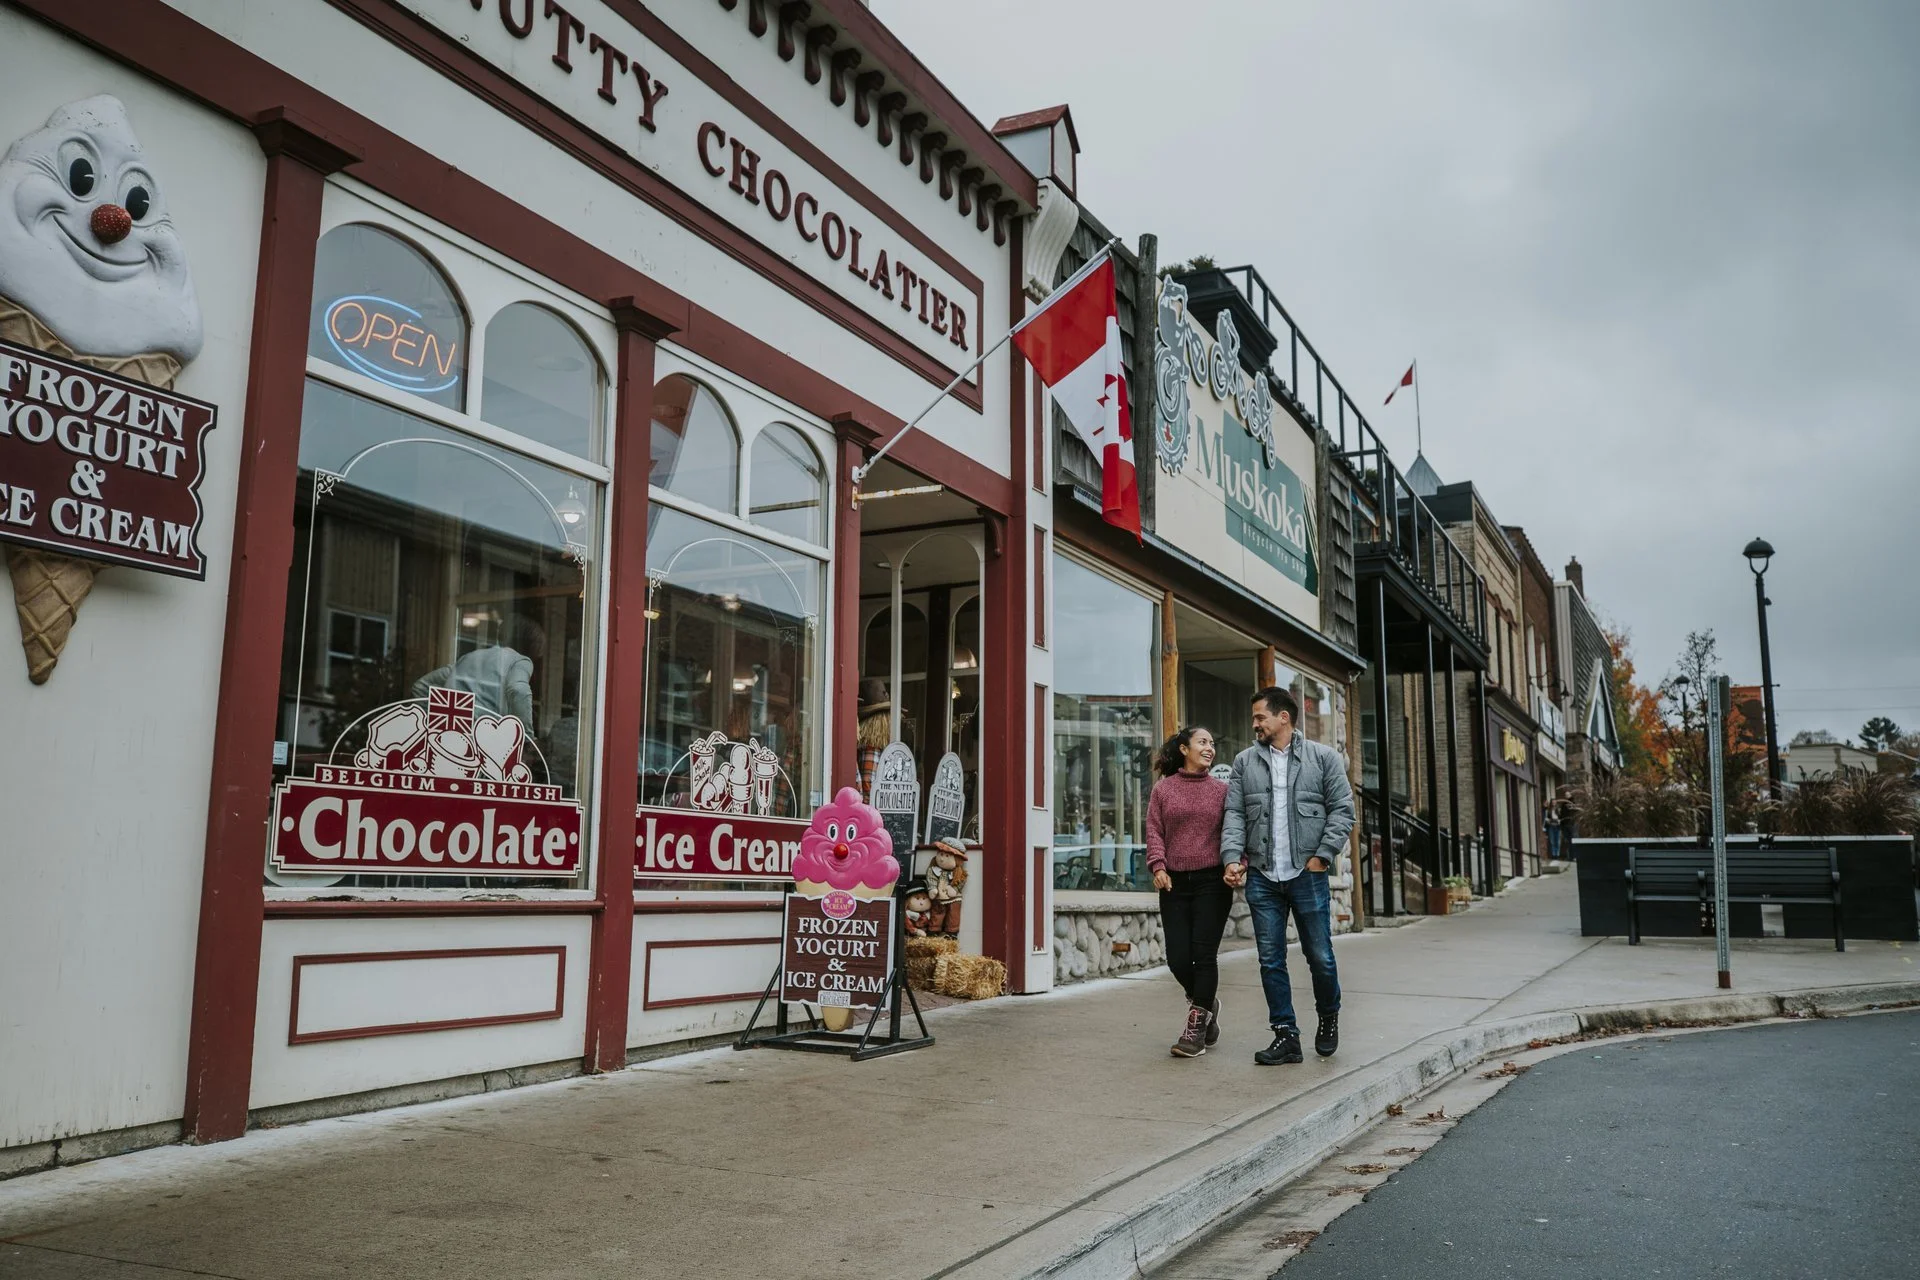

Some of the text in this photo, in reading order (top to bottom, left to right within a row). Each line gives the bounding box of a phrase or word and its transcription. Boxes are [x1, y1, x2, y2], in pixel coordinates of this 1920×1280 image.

[469, 0, 969, 351] UTTY CHOCOLATIER
[331, 302, 456, 375] OPEN
[0, 353, 186, 441] FROZEN
[70, 460, 106, 500] &
[1195, 415, 1307, 553] Muskoka
[51, 497, 191, 558] CREAM
[321, 768, 557, 800] BELGIUM BRITISH
[299, 796, 567, 866] Chocolate
[644, 818, 695, 870] Ice
[794, 937, 879, 958] YOGURT
[797, 917, 879, 937] FROZEN
[786, 971, 885, 994] ICE CREAM
[827, 958, 847, 972] &
